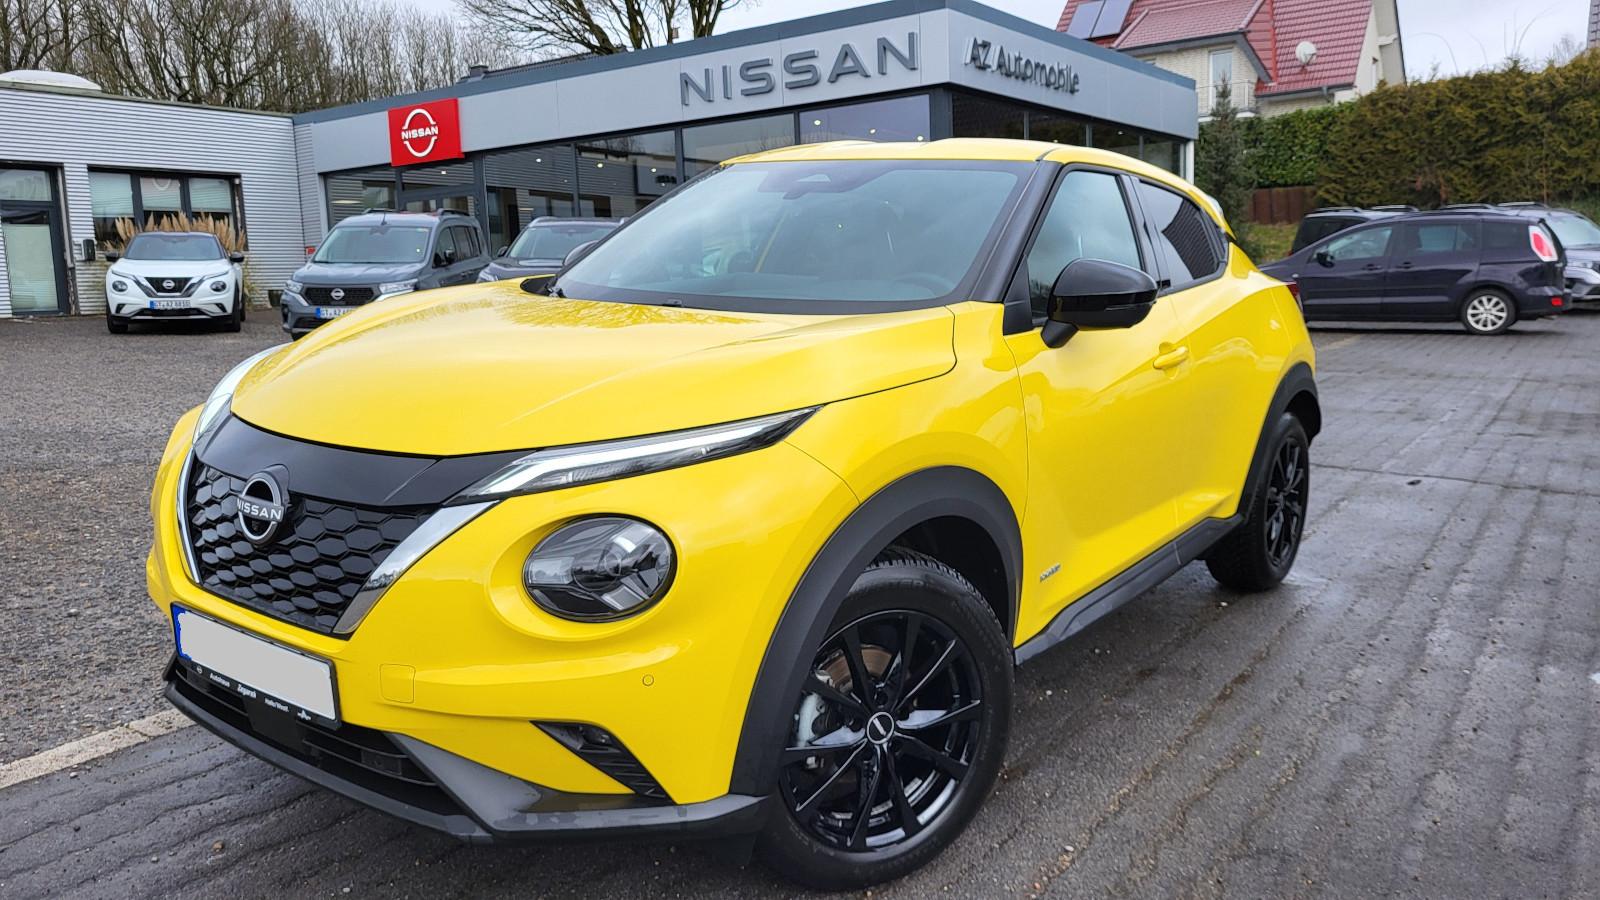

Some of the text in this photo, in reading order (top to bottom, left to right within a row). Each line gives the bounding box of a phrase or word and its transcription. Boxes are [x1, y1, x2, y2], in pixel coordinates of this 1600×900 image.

[680, 31, 918, 106] NISSAN
[963, 37, 1080, 94] AZ Automobile
[401, 126, 439, 140] NISSAN
[237, 497, 282, 520] NISSAN
